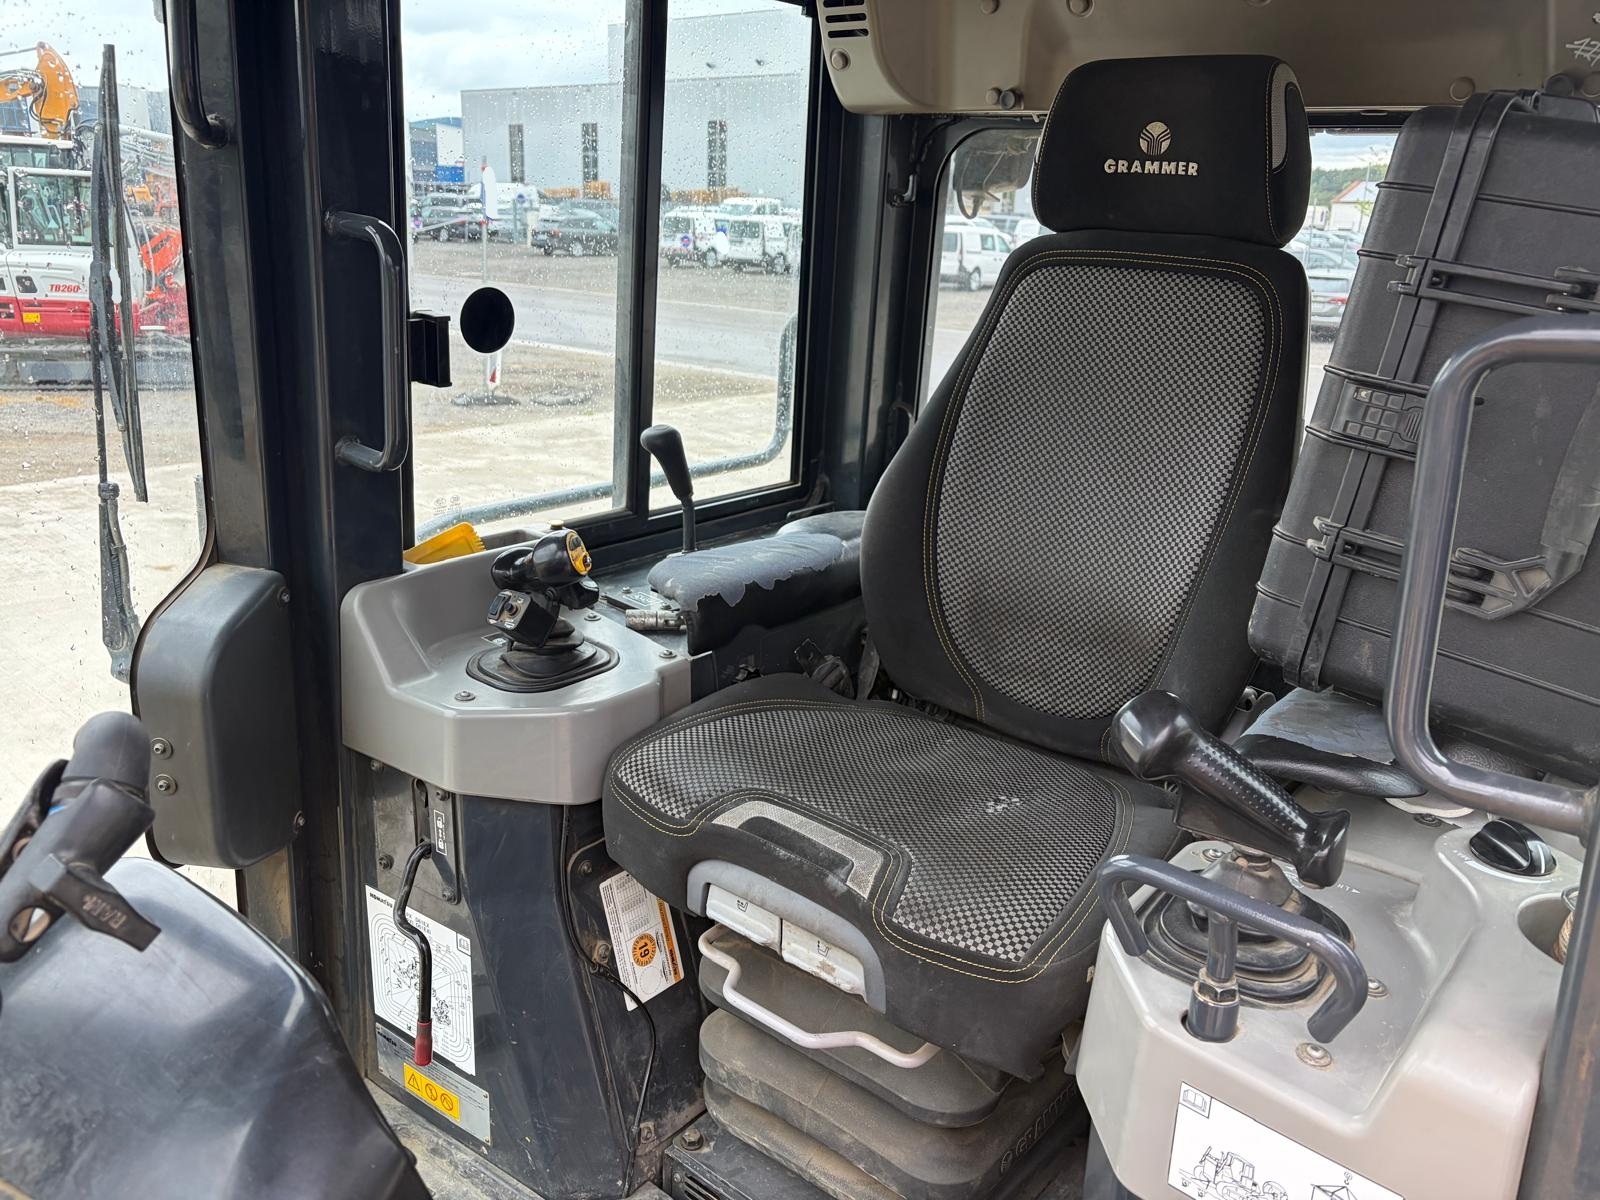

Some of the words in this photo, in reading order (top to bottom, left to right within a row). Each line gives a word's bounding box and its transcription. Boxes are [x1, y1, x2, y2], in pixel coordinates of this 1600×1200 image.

[1104, 159, 1198, 176] GRAMMER
[50, 284, 81, 293] TB260
[638, 942, 650, 958] 19
